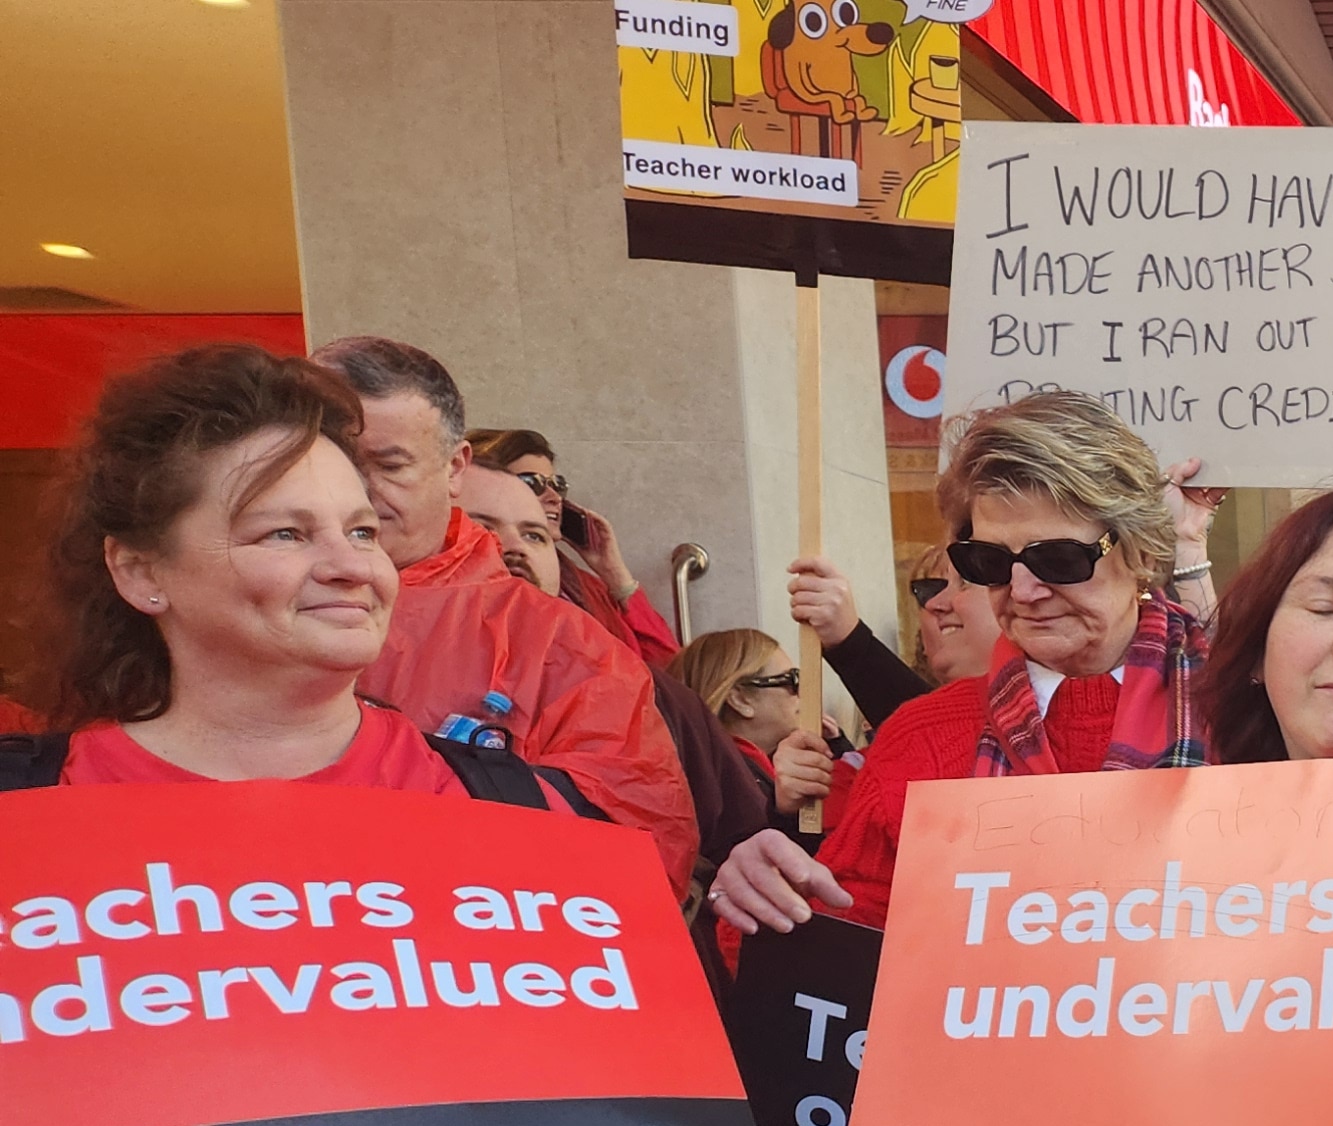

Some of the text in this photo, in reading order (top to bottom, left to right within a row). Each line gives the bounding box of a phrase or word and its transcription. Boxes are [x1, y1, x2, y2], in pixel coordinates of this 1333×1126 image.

[615, 10, 729, 46] Funding
[624, 152, 846, 192] Teacher workload
[986, 153, 1029, 239] I
[1054, 165, 1230, 226] WOULD
[992, 246, 1116, 296] MADE
[1137, 243, 1313, 293] ANOTHER
[988, 314, 1075, 356] BUT
[1102, 321, 1123, 362] I
[1139, 317, 1230, 358] RAN
[1256, 317, 1319, 353] OUT
[0, 862, 622, 951] achers are
